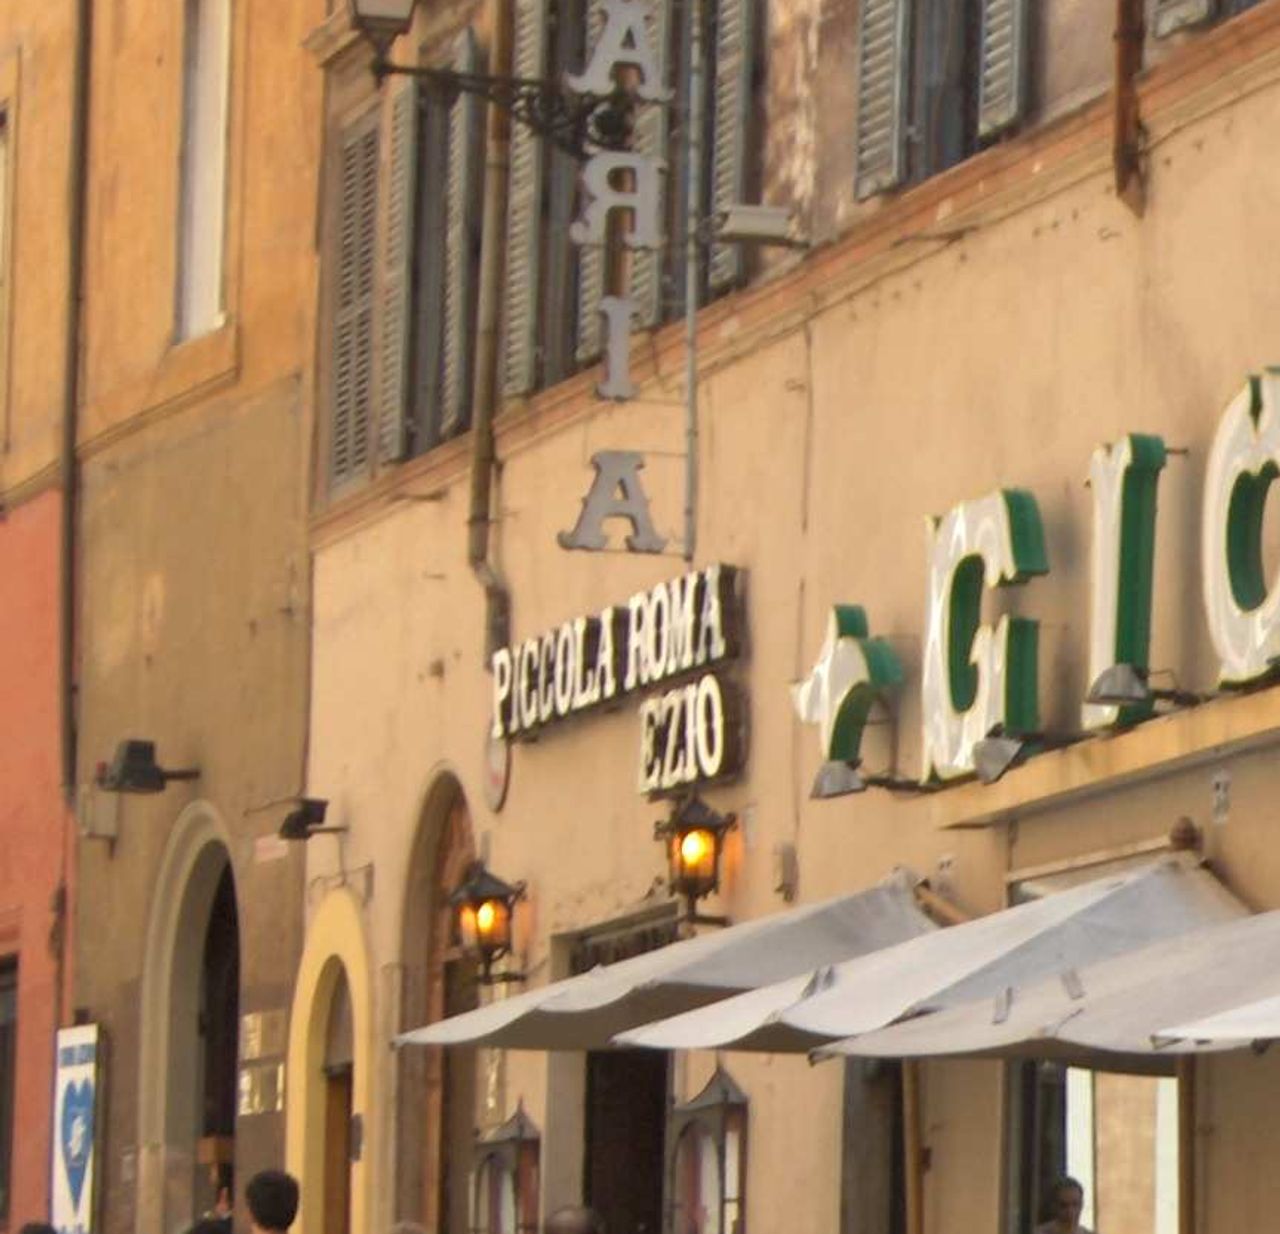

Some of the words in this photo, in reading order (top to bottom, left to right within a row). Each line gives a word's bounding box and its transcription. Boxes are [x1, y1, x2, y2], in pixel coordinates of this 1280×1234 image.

[491, 605, 616, 739] PICCOLA
[624, 564, 725, 692] ROMA
[638, 672, 724, 795] EZIO
